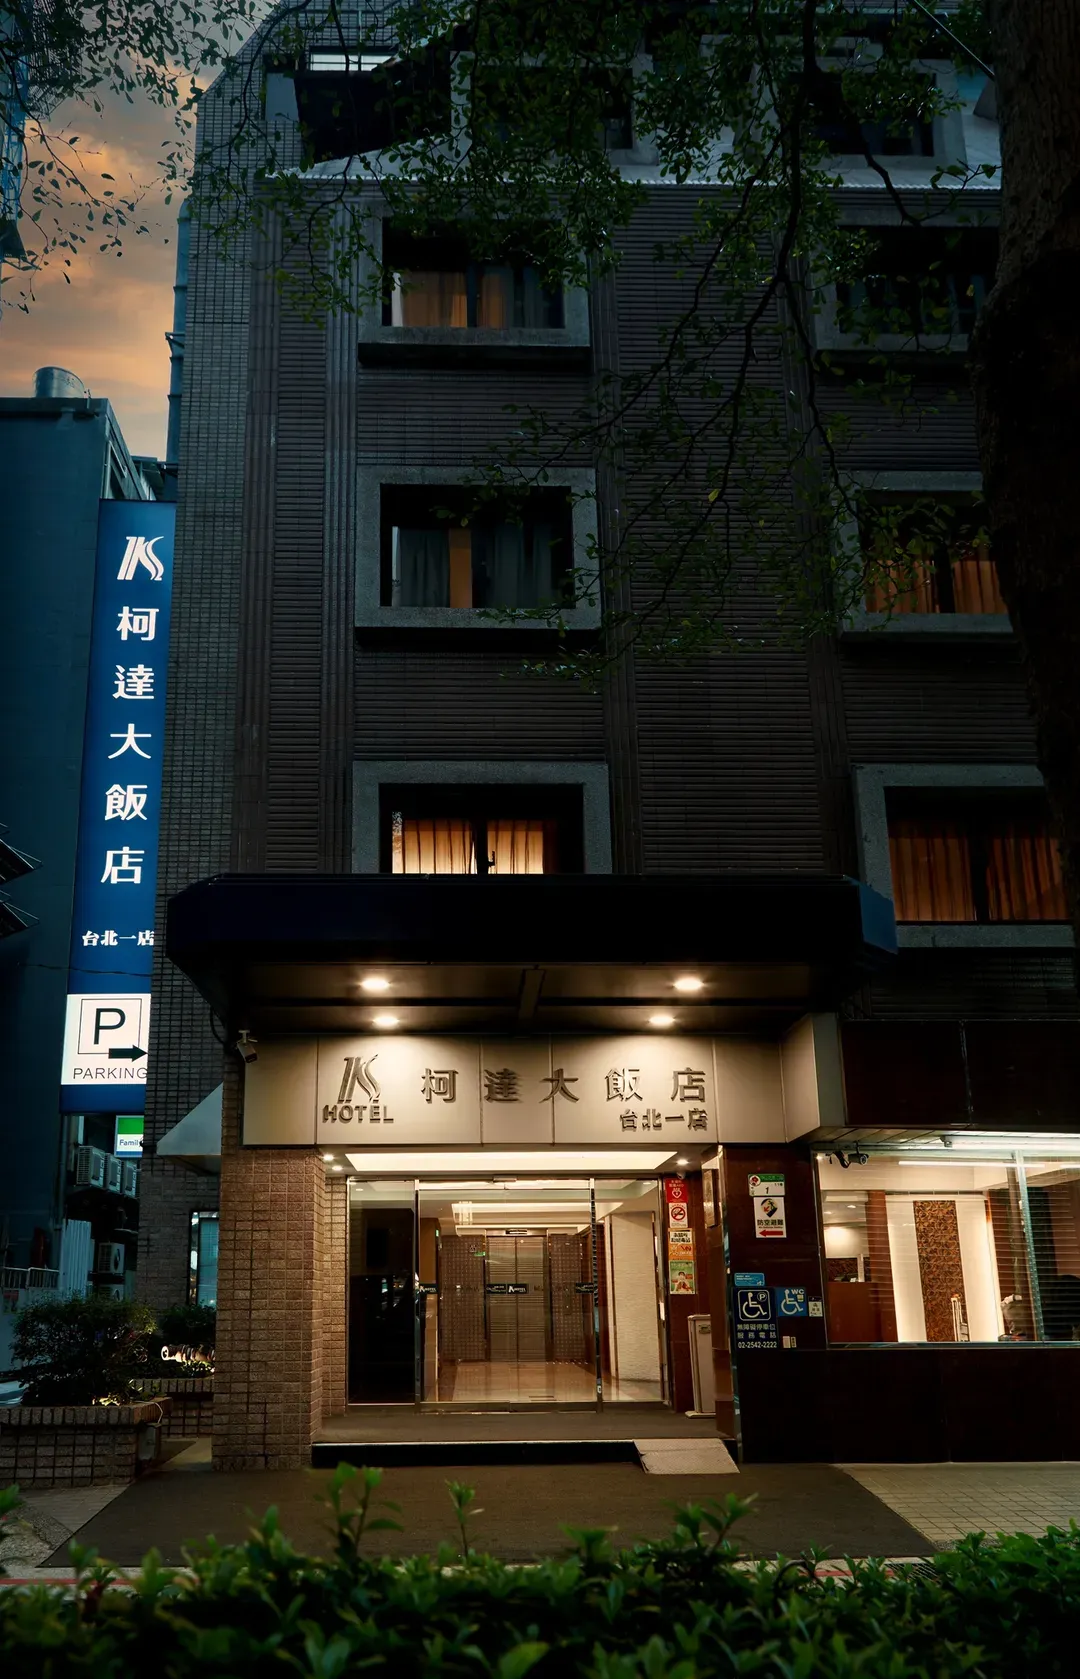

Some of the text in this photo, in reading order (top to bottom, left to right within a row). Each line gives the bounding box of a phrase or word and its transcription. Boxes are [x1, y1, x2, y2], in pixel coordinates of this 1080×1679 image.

[101, 606, 159, 884] 柯達大飯店
[82, 930, 155, 947] 台北一店
[93, 1008, 126, 1045] P
[73, 1067, 148, 1080] PARKING
[421, 1067, 707, 1103] 柯達大飯店
[322, 1104, 395, 1124] HOTEL
[619, 1108, 708, 1131] 台北一店
[737, 1341, 777, 1349] 02-2542-2222
